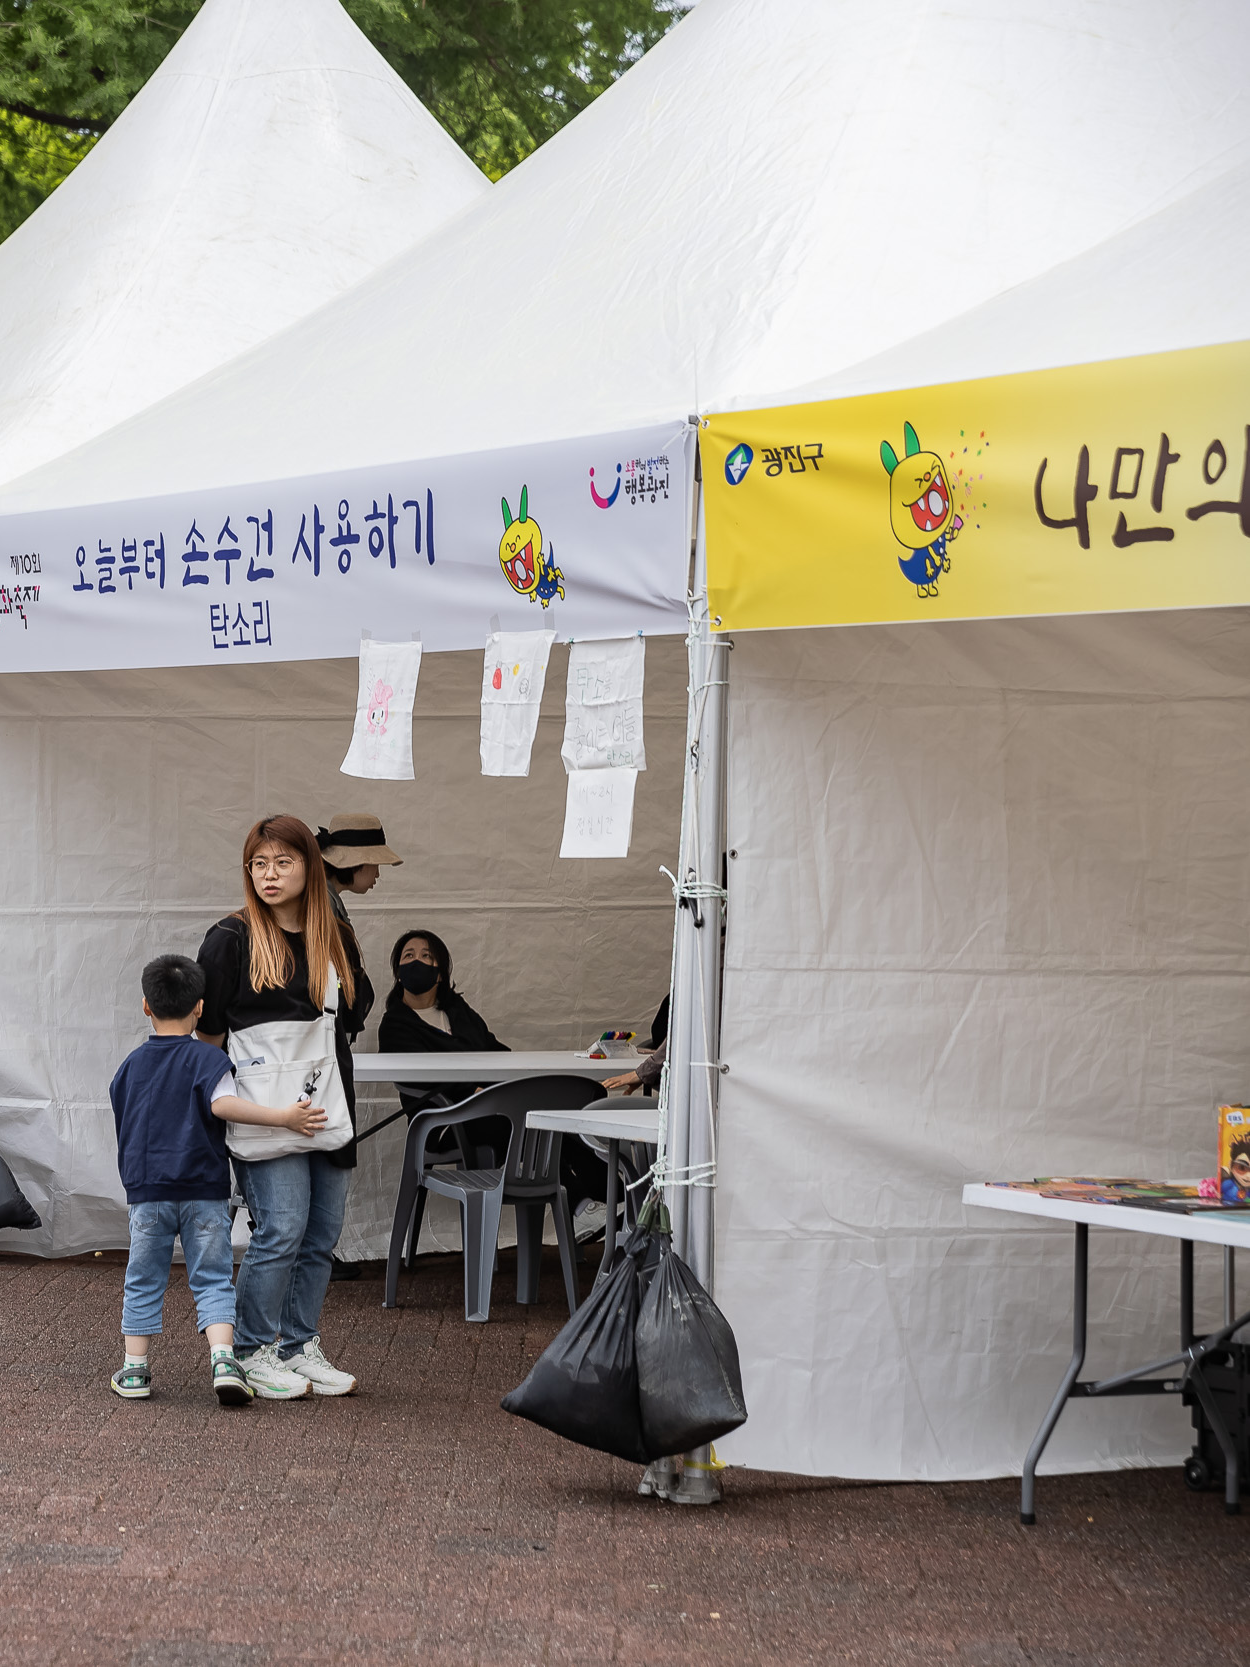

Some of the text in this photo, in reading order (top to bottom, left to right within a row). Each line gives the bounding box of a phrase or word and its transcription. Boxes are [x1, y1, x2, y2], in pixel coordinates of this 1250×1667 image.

[760, 443, 824, 477] 광진구
[625, 473, 669, 505] 행복광진
[1034, 423, 1250, 549] 나만의
[73, 488, 435, 594] 오늘부터 손수건 사용하기
[10, 552, 41, 575] 제10회
[209, 600, 272, 649] 탄소리
